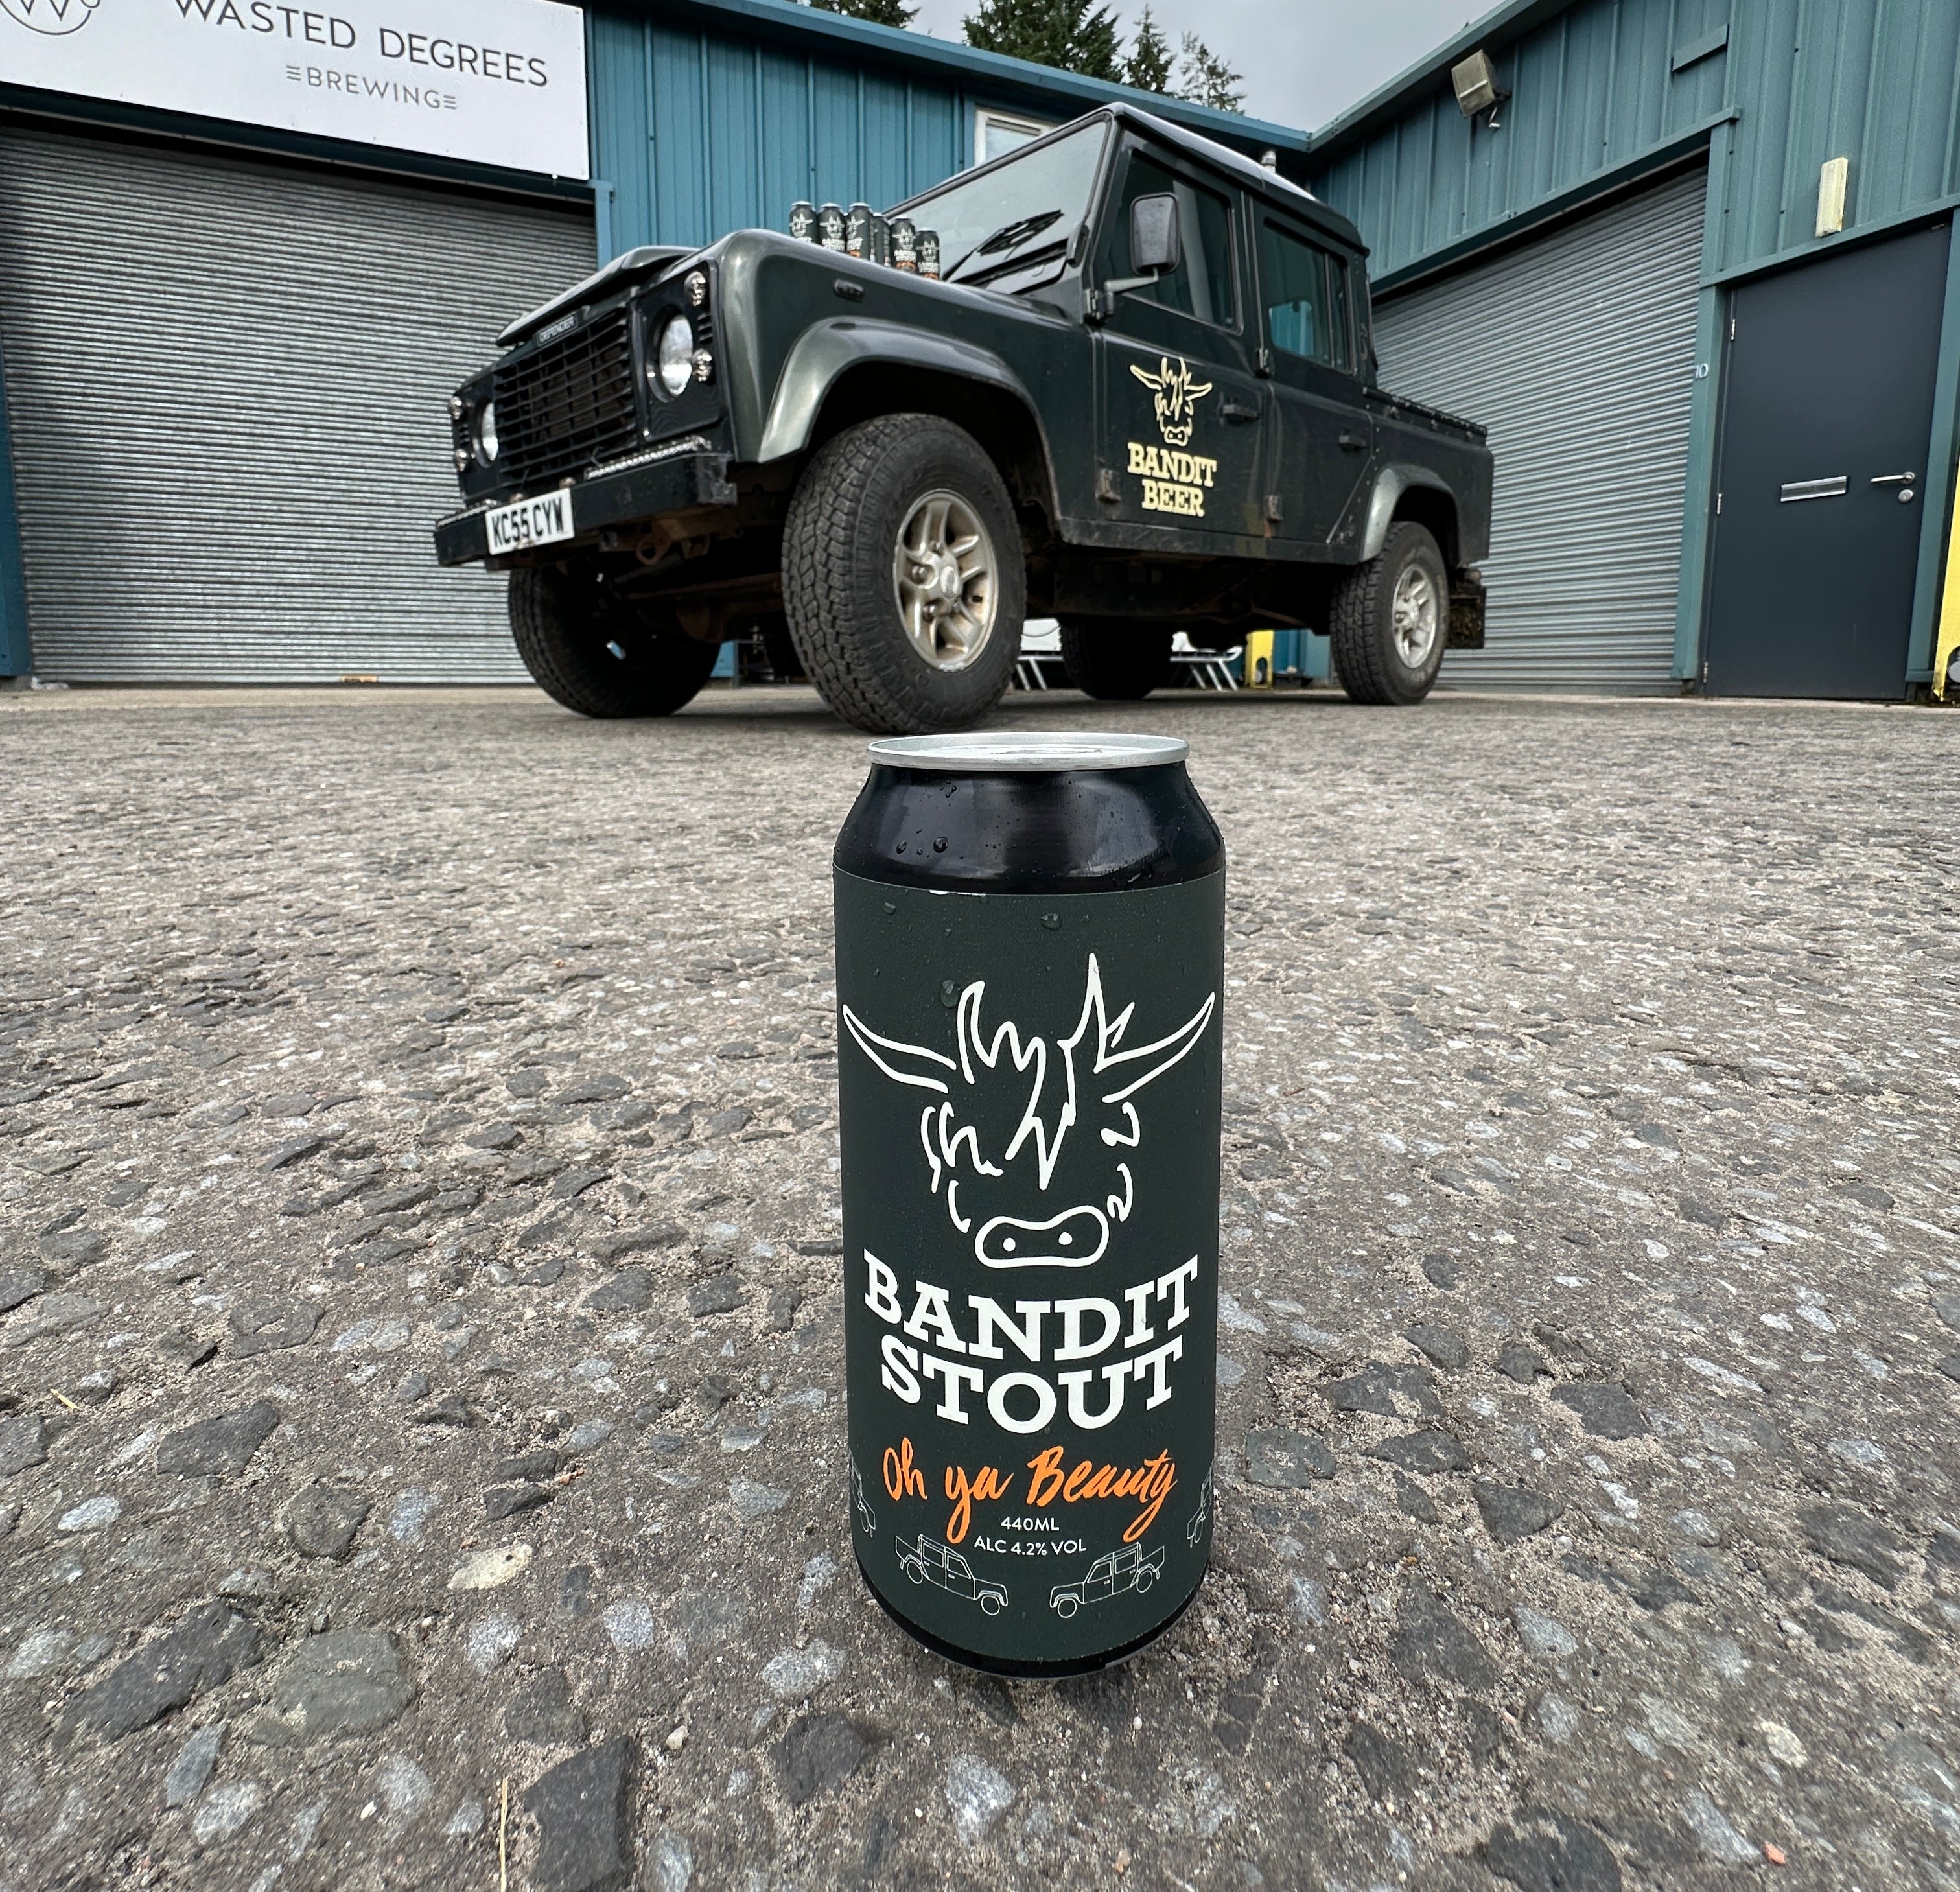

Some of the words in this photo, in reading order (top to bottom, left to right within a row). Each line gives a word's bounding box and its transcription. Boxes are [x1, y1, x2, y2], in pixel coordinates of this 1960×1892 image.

[174, 0, 356, 49] WASTED
[379, 27, 548, 87] DEGREES
[307, 66, 441, 109] BREWING
[1127, 442, 1217, 487] BANDIT
[1141, 479, 1205, 517] BEER
[491, 507, 530, 548] KC55
[533, 497, 563, 537] CYW
[863, 1248, 1199, 1362] BANDIT
[881, 1334, 1184, 1434] STOUT
[882, 1436, 929, 1501] Oh
[944, 1464, 1014, 1545] ya
[1025, 1445, 1179, 1543] Beauty
[974, 1536, 1007, 1553] ALC
[1010, 1541, 1047, 1556] 4.2%
[1051, 1539, 1087, 1555] VOL
[1000, 1516, 1060, 1531] 440ML
